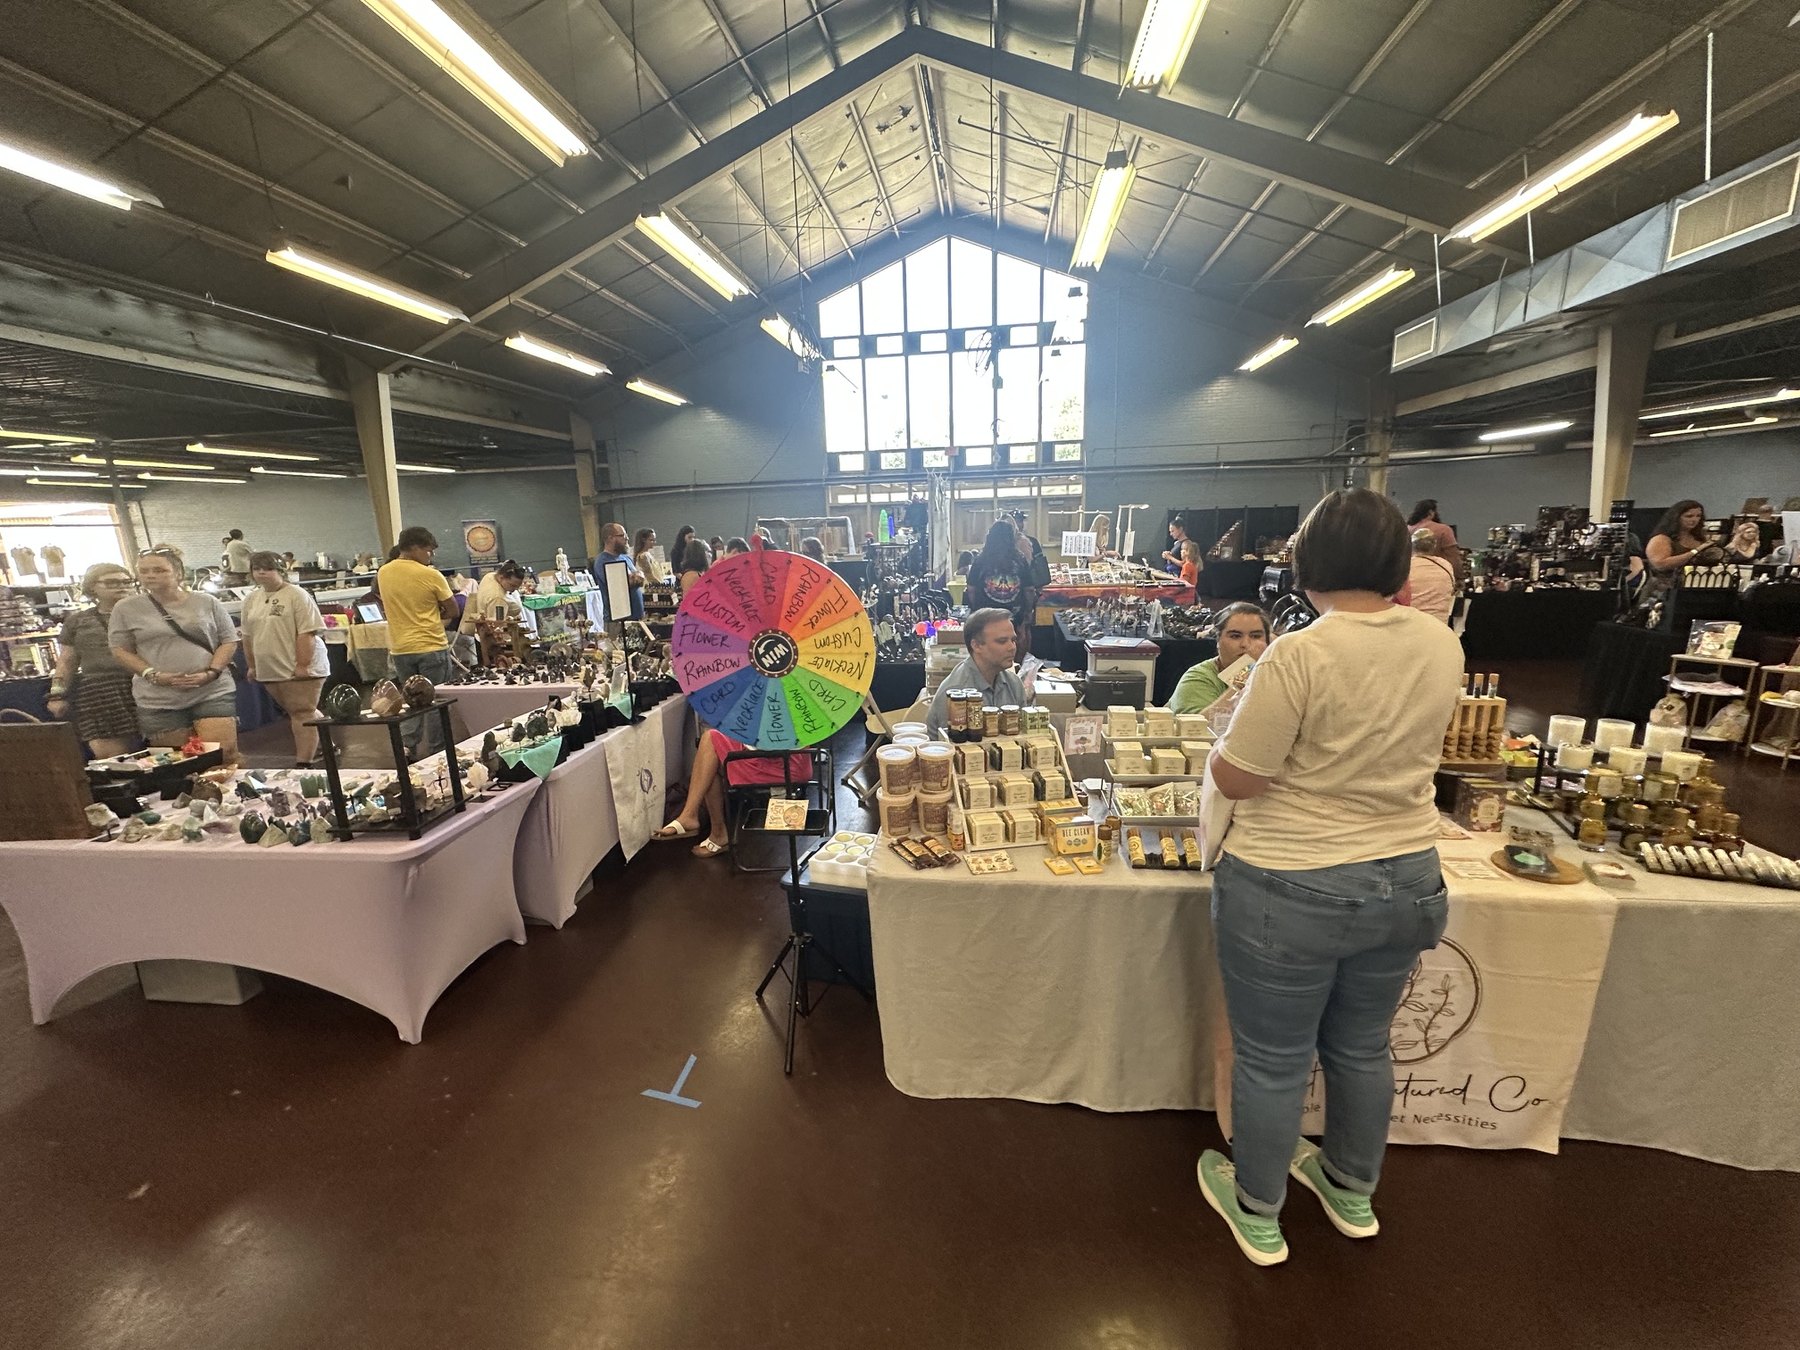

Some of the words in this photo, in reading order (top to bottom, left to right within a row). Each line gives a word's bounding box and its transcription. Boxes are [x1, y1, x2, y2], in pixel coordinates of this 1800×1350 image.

[759, 562, 778, 605] CARD
[784, 563, 820, 623] RAINBOW
[700, 681, 736, 715] CARD
[808, 679, 847, 712] CARD
[1393, 1073, 1473, 1108] tured
[1413, 1113, 1498, 1131] Necessities
